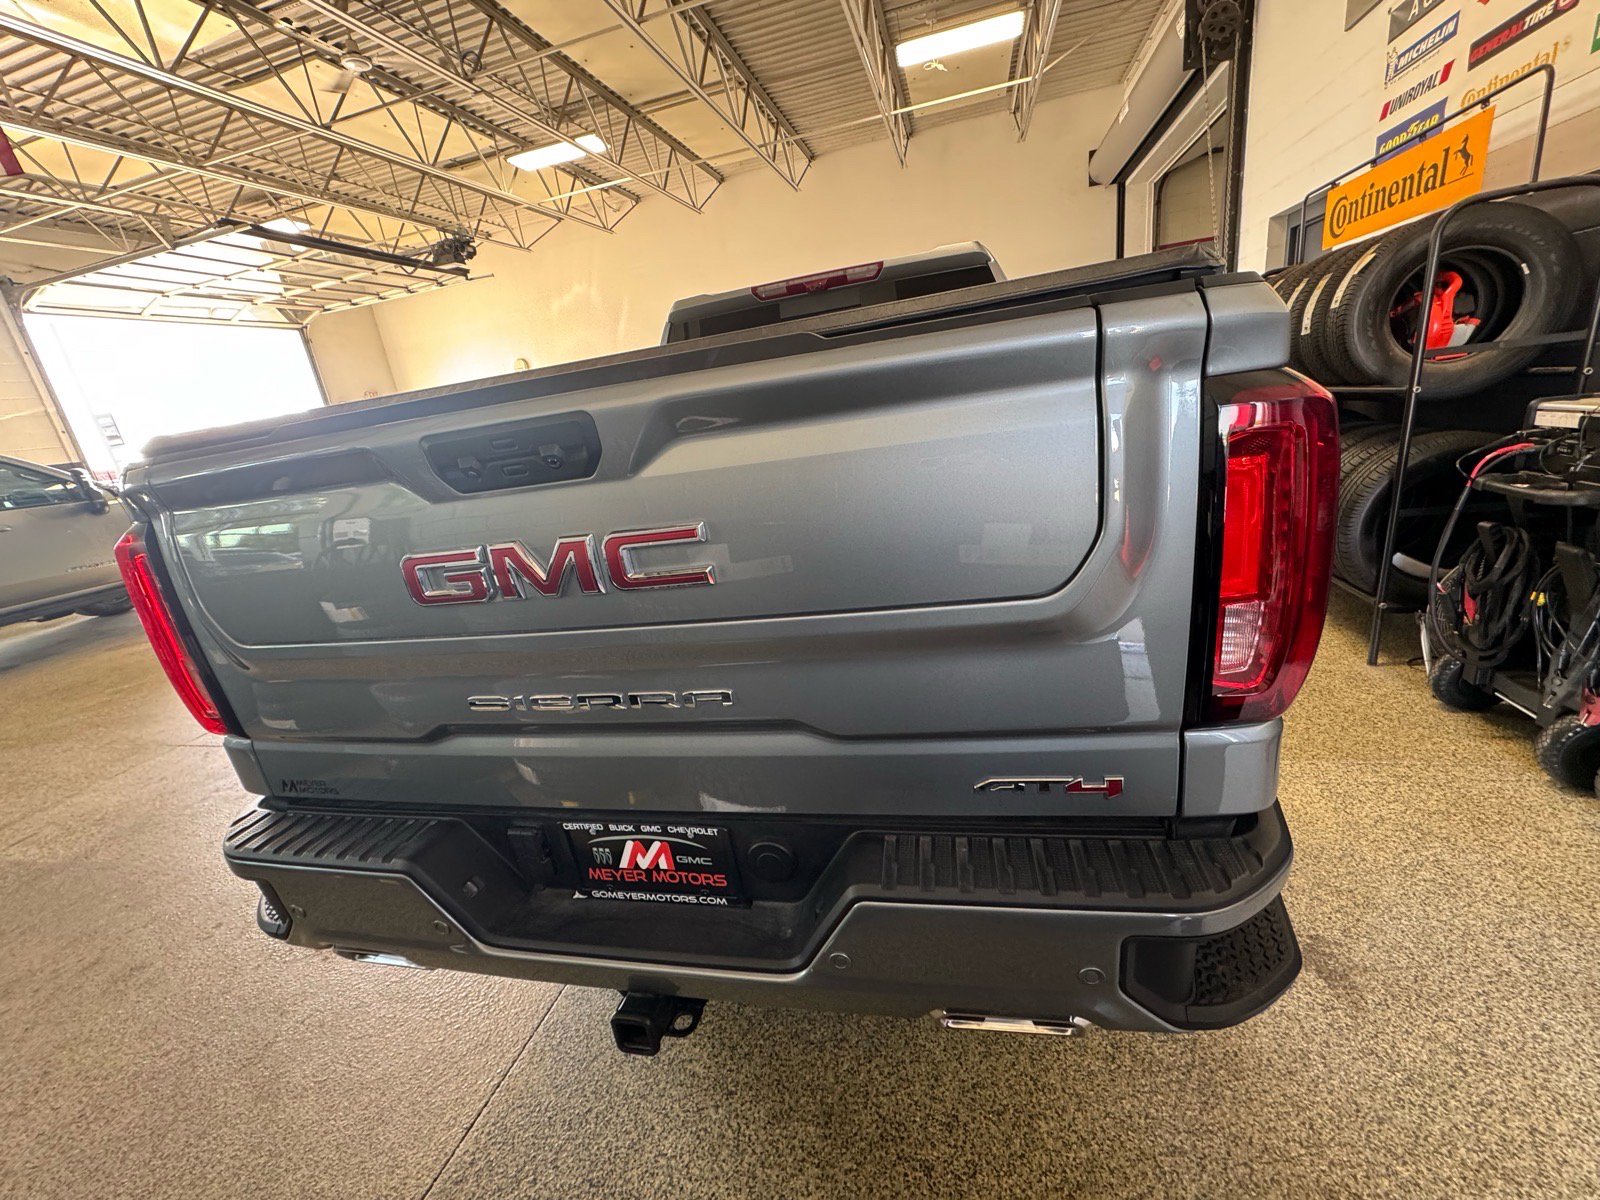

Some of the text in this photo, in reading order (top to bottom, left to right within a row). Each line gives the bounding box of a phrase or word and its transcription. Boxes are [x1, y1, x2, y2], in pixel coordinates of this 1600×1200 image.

[1397, 16, 1458, 70] MICHELIN
[1460, 41, 1559, 108] Continental
[1389, 70, 1441, 115] UNIROYAL
[1329, 146, 1450, 240] Continental
[400, 521, 715, 607] GMC
[467, 688, 734, 712] SIERRA
[973, 775, 1125, 799] AT4
[562, 822, 719, 836] CERTIFIED BUICK GMC CHEVROLET
[676, 855, 713, 865] GMC
[588, 867, 728, 887] MEYER MOTORS
[591, 890, 728, 905] GOMEYERMOTORS.COM
